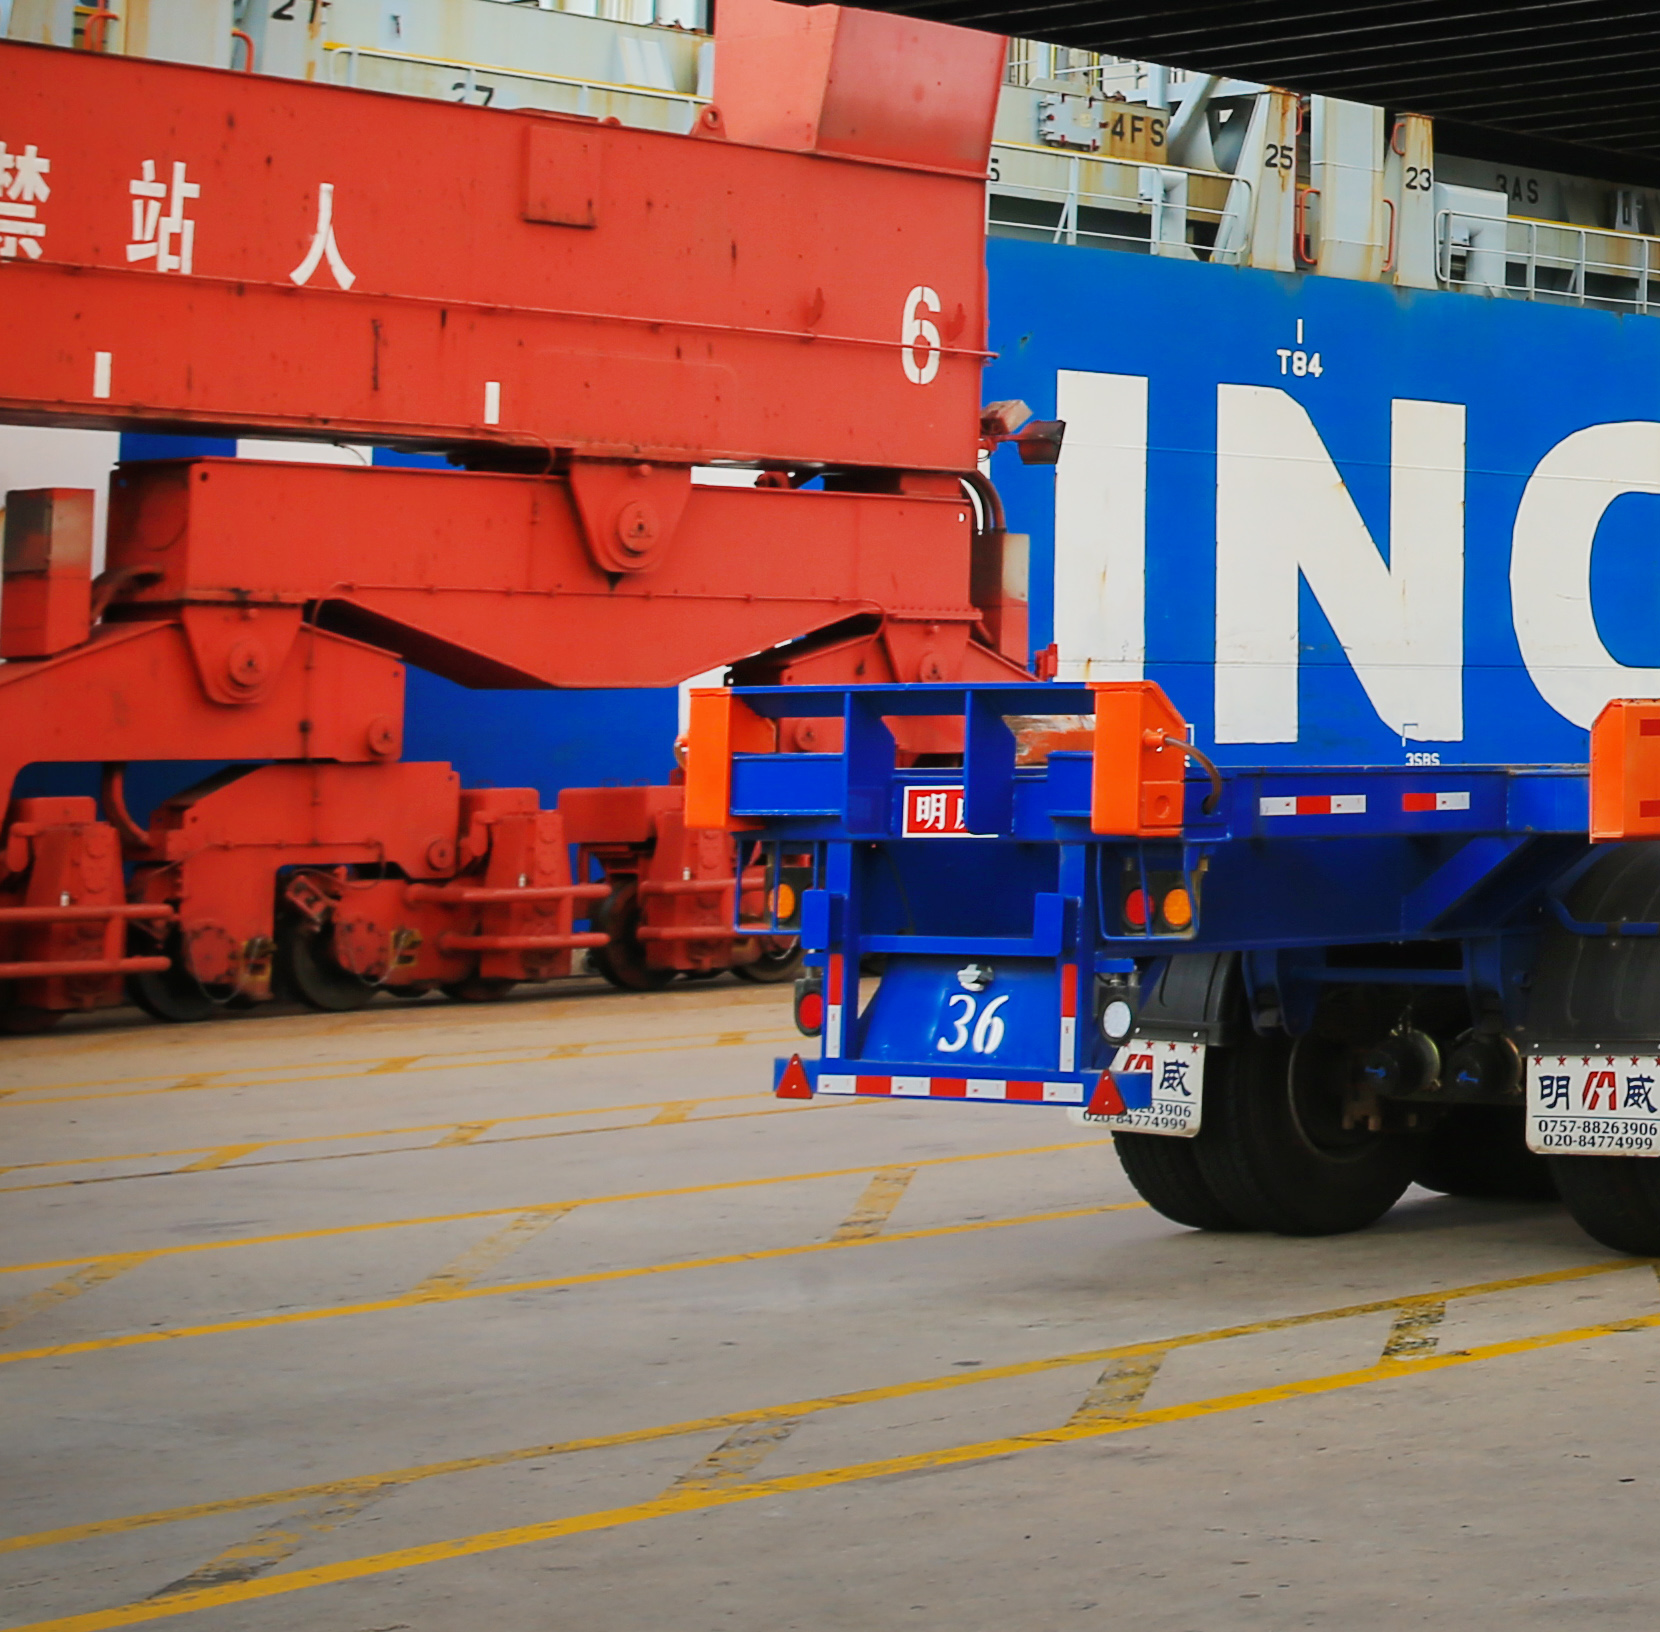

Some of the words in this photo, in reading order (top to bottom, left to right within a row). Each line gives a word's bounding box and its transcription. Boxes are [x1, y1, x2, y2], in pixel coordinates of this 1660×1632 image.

[1110, 116, 1166, 148] 4FS
[1264, 143, 1294, 171] 25
[1405, 165, 1433, 192] 23
[900, 284, 941, 385] 6
[1276, 348, 1323, 378] T84
[937, 994, 1010, 1055] 36
[1159, 1059, 1192, 1097] 威
[1538, 1119, 1658, 1136] 0757-88263906
[1543, 1134, 1653, 1150] 020-84774999
